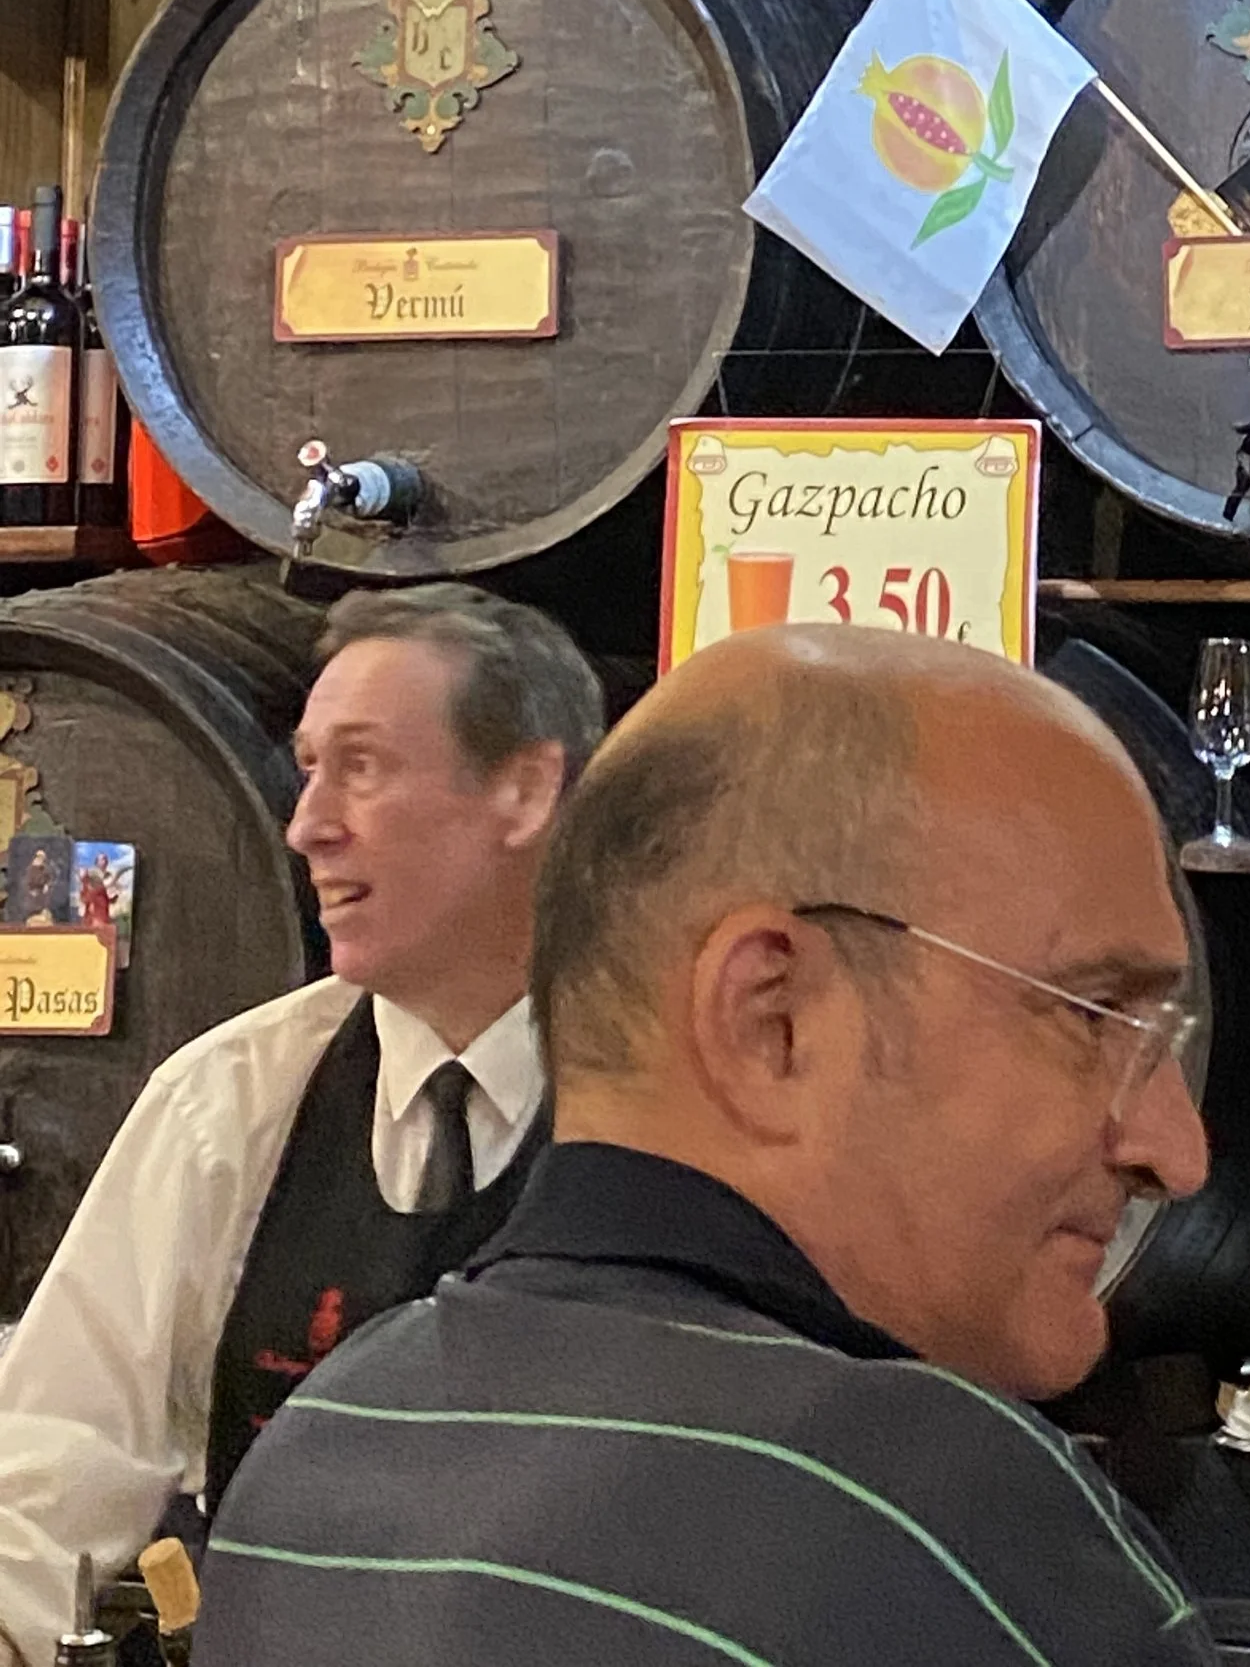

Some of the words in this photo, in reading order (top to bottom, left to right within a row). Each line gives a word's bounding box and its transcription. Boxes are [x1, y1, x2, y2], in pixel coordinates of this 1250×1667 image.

[364, 283, 465, 320] Vermú
[728, 465, 967, 536] Gazpacho
[4, 976, 100, 1022] Pasas
